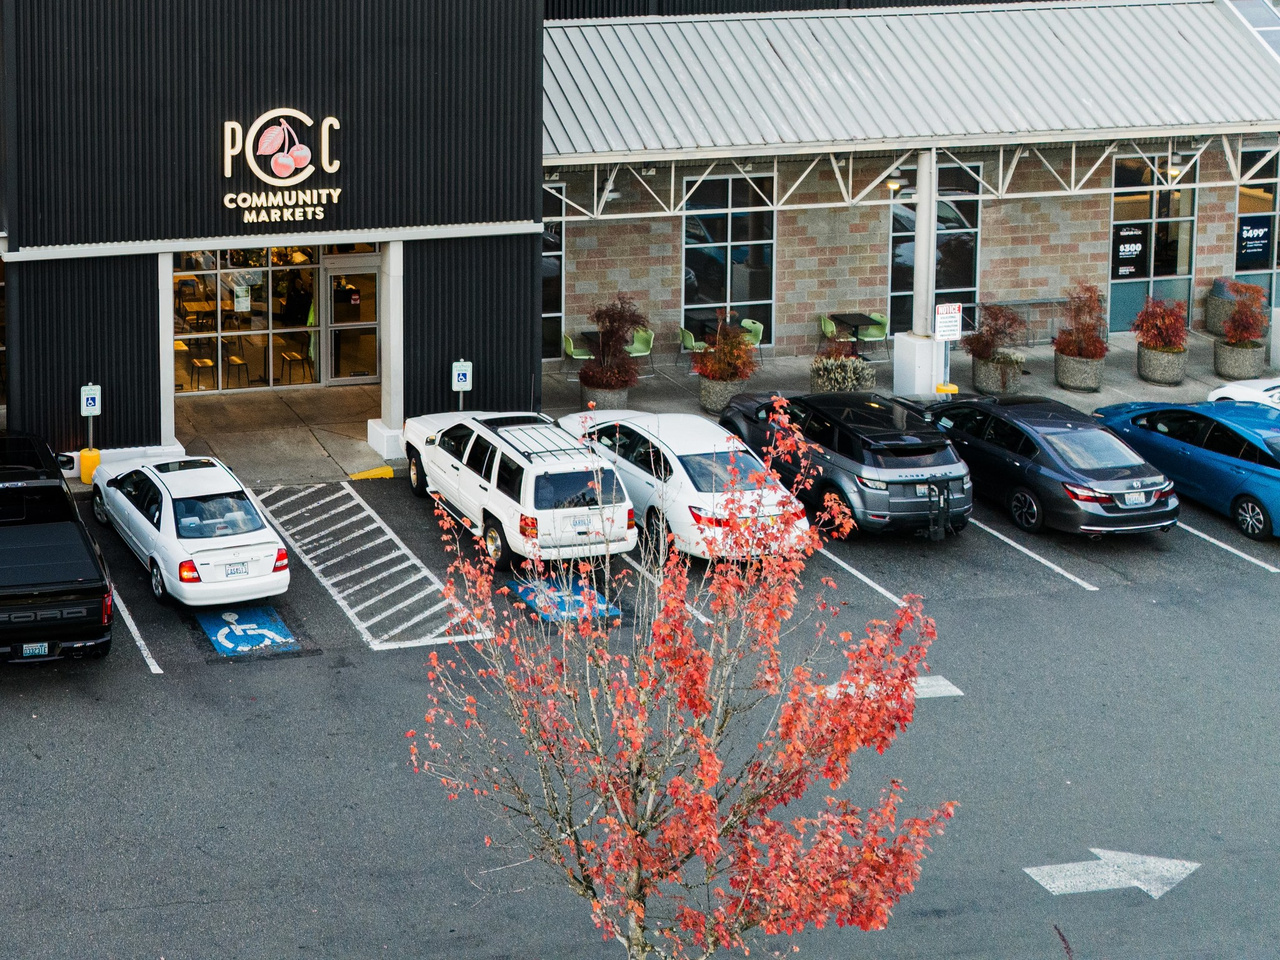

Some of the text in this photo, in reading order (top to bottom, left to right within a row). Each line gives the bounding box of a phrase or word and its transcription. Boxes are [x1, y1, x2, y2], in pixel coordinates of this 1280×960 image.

[224, 108, 341, 187] PCC
[223, 188, 342, 209] COMMUNITY
[243, 207, 325, 224] MARKETS
[939, 305, 960, 315] NOTICE
